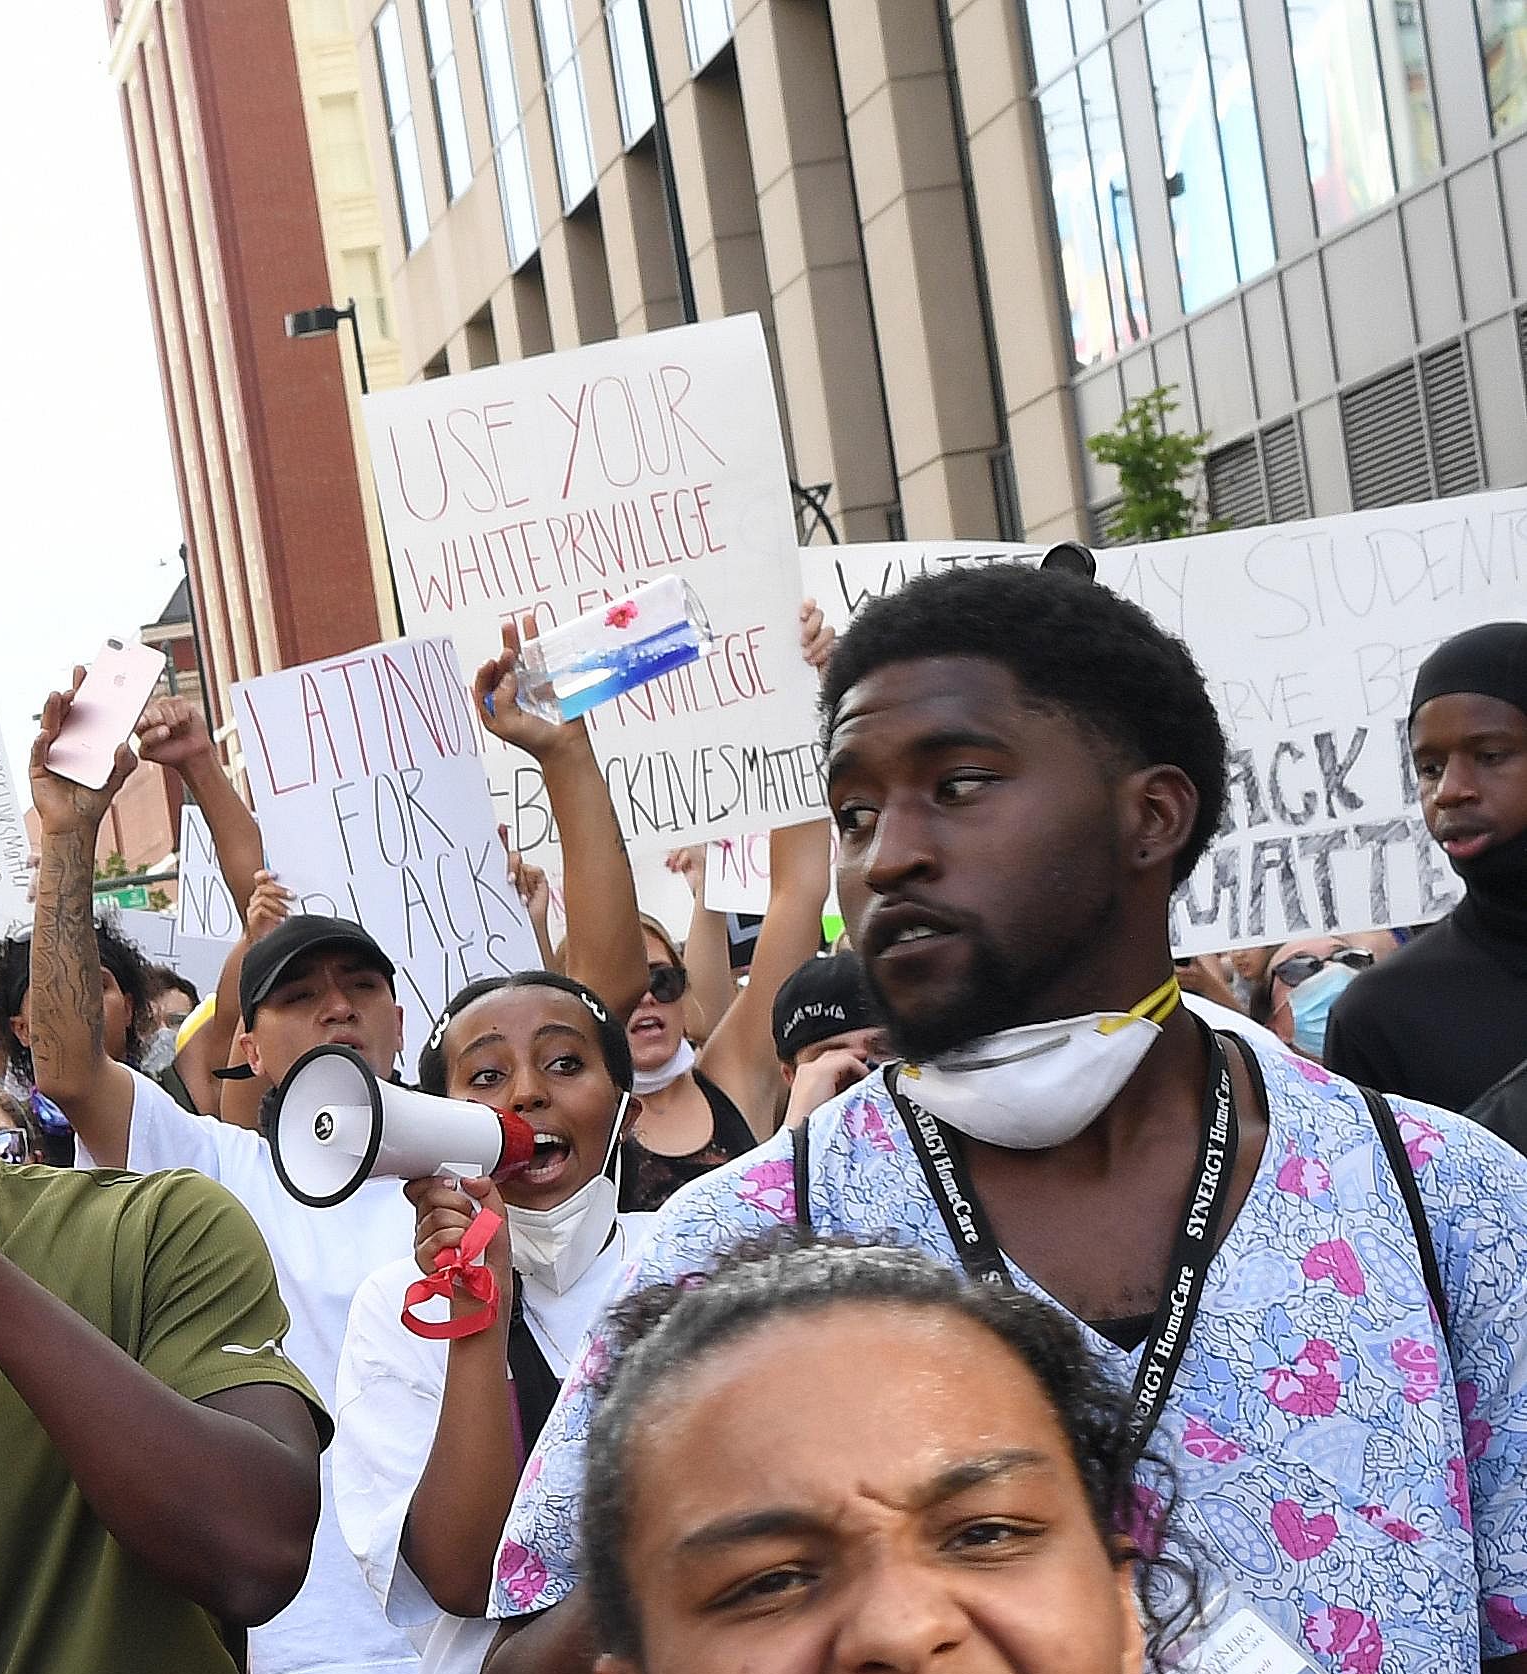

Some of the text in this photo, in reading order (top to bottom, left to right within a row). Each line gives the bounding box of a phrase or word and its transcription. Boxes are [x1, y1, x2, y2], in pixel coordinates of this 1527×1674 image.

[388, 365, 726, 522] USE YOUR
[403, 519, 551, 614] WHITE
[551, 482, 727, 588] PRIVILEGE
[244, 639, 479, 796] LATINOS
[332, 767, 455, 876] FOR
[1220, 726, 1370, 839] ACK
[179, 875, 234, 938] NO
[1169, 818, 1461, 948] MATTE
[932, 1155, 980, 1245] HomeCare
[1186, 1142, 1224, 1241] SYNERGY
[1154, 1265, 1195, 1360] HomeCare
